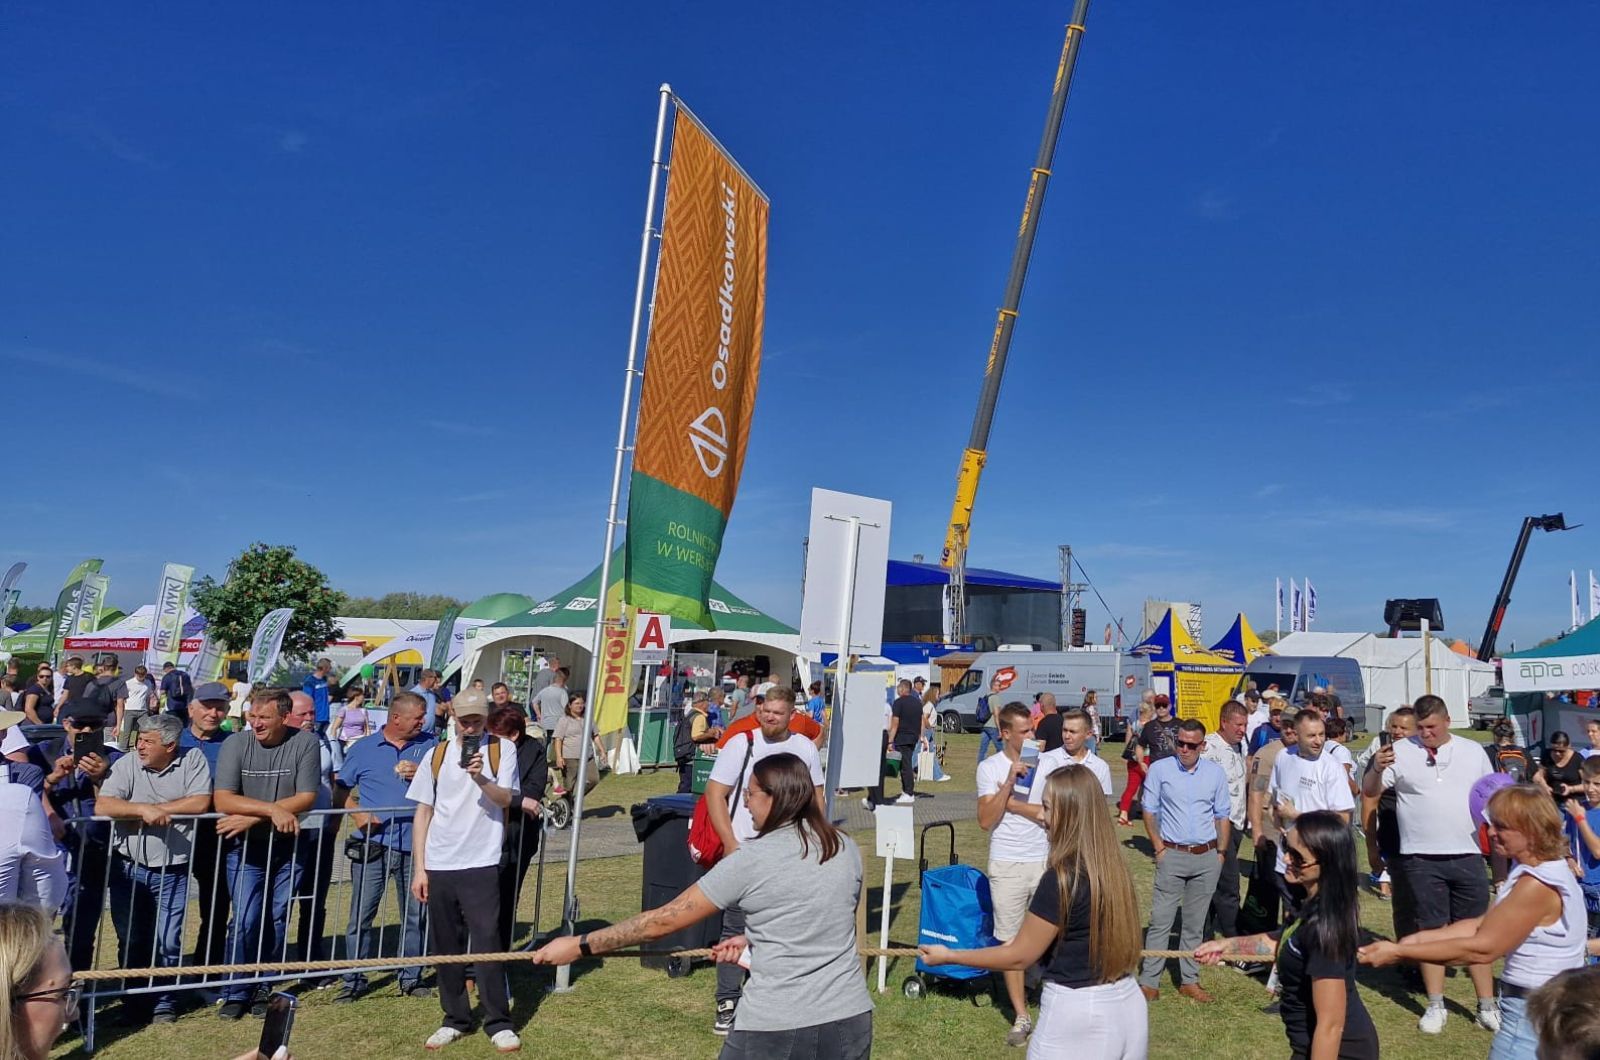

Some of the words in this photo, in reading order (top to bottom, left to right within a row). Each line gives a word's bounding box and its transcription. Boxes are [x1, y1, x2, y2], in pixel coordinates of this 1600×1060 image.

[711, 181, 736, 390] Osadkowski
[657, 540, 673, 558] W
[639, 617, 665, 648] A
[1519, 661, 1564, 685] apra
